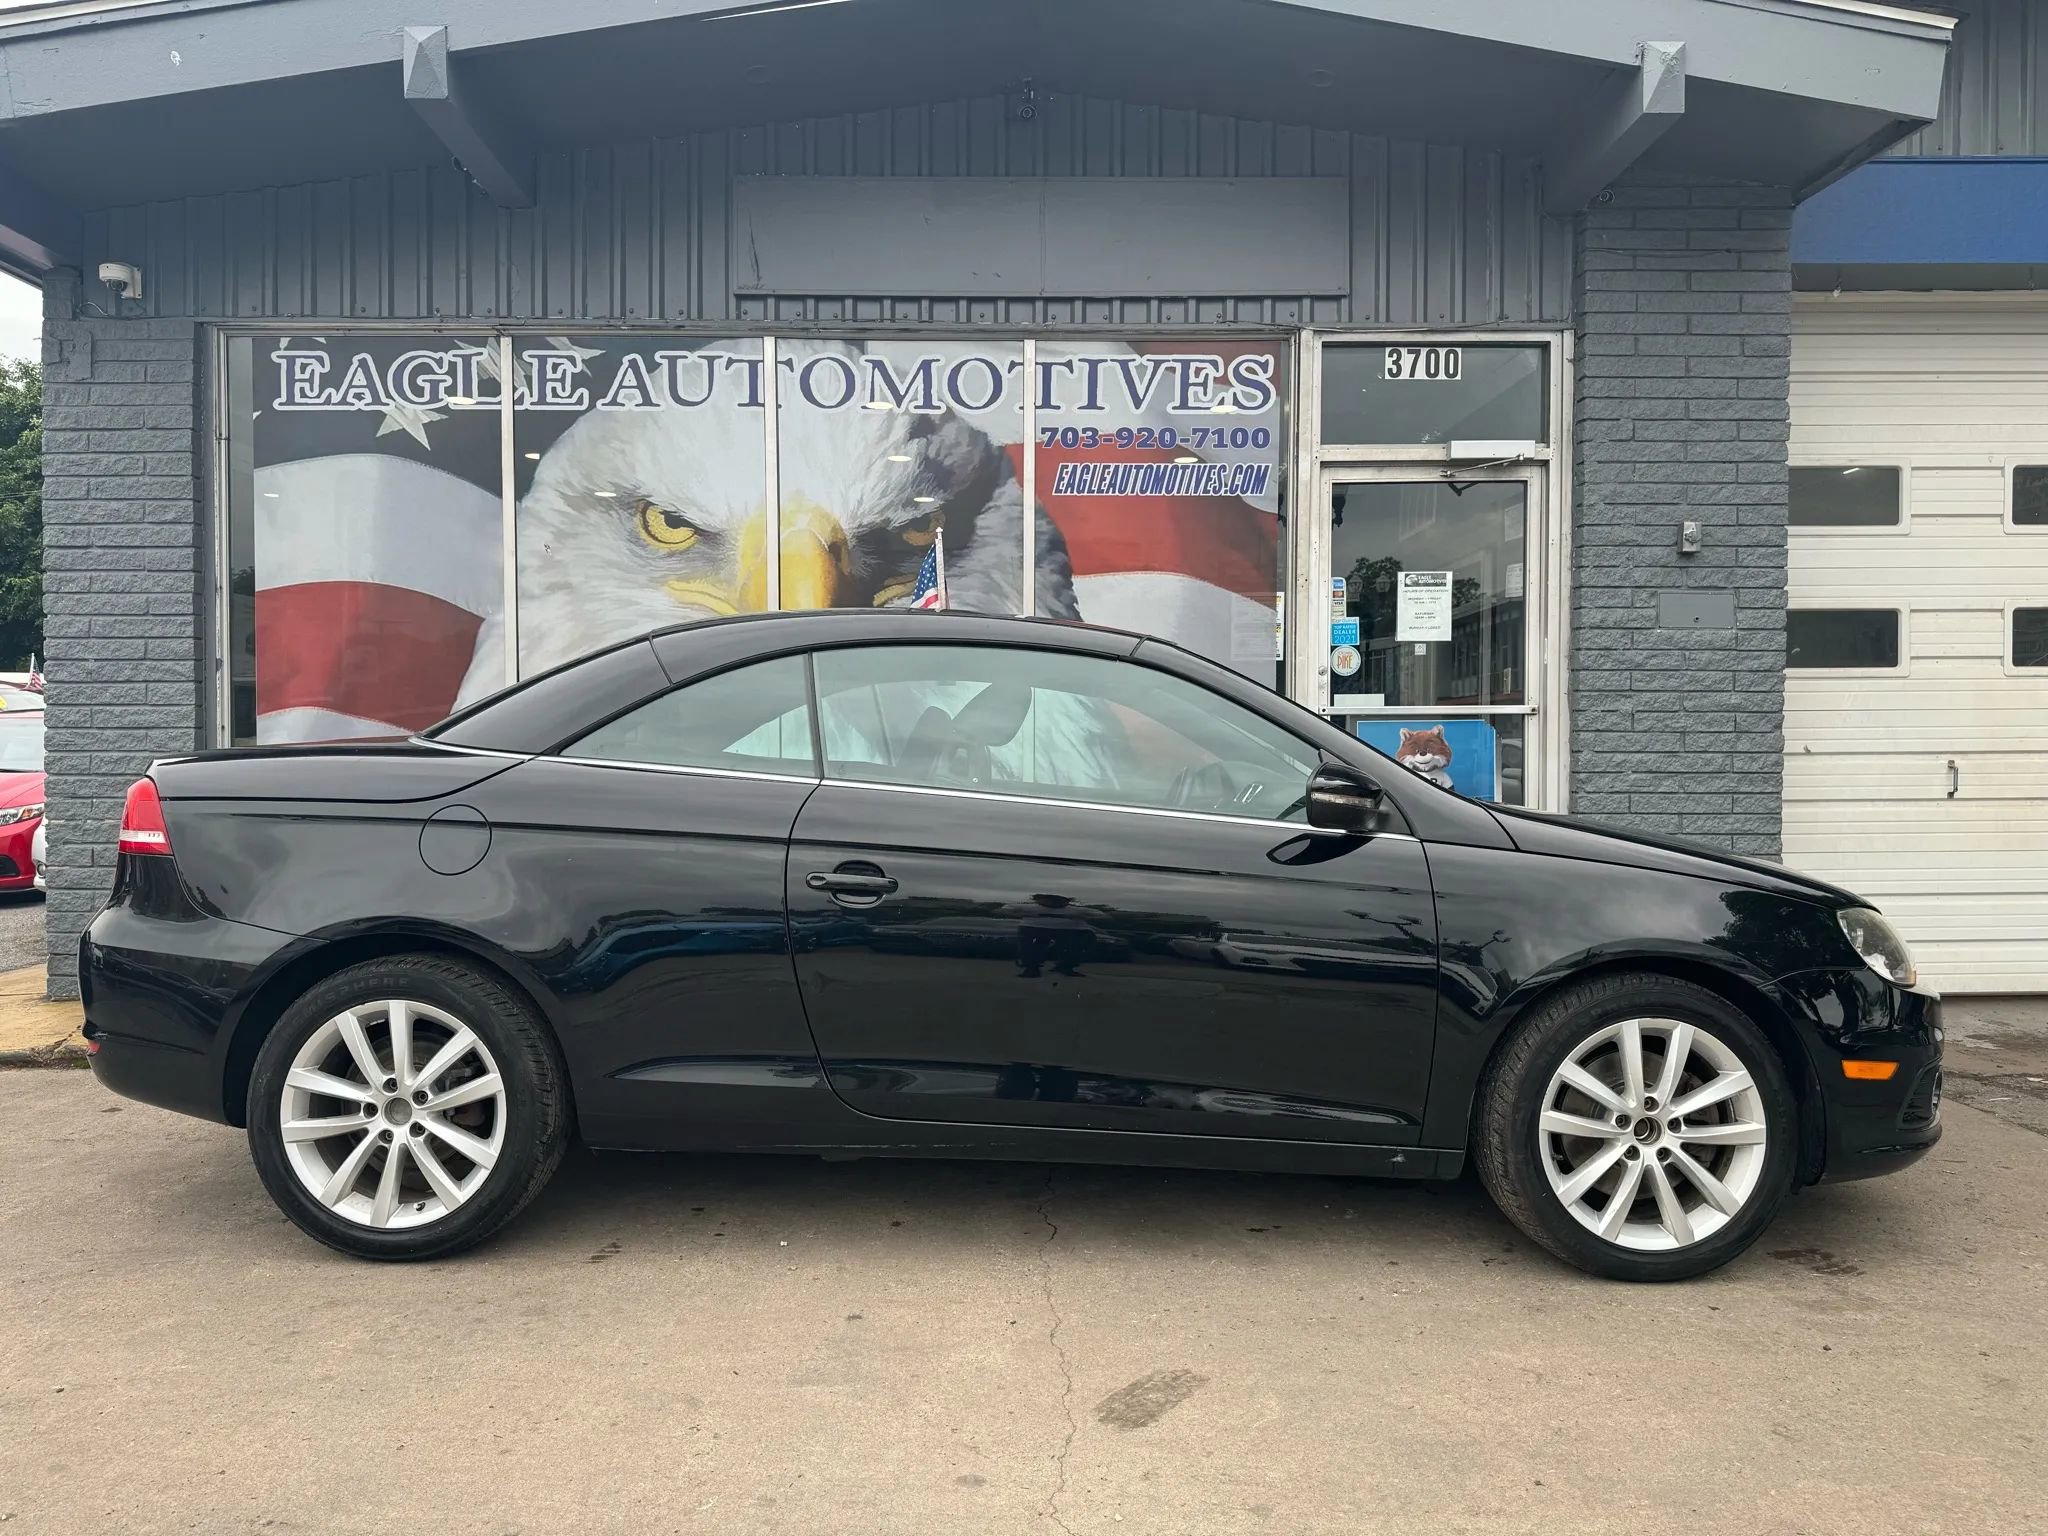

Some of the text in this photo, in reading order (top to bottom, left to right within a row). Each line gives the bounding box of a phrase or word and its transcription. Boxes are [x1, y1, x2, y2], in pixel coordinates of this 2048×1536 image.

[1387, 348, 1460, 379] 3700
[272, 350, 1276, 415] EAGLE AUTOMOTIVES
[1040, 426, 1271, 450] 703-920-7100
[1052, 463, 1272, 496] EAGLEAUTOMOTIVES.COM
[1334, 635, 1356, 644] 2021
